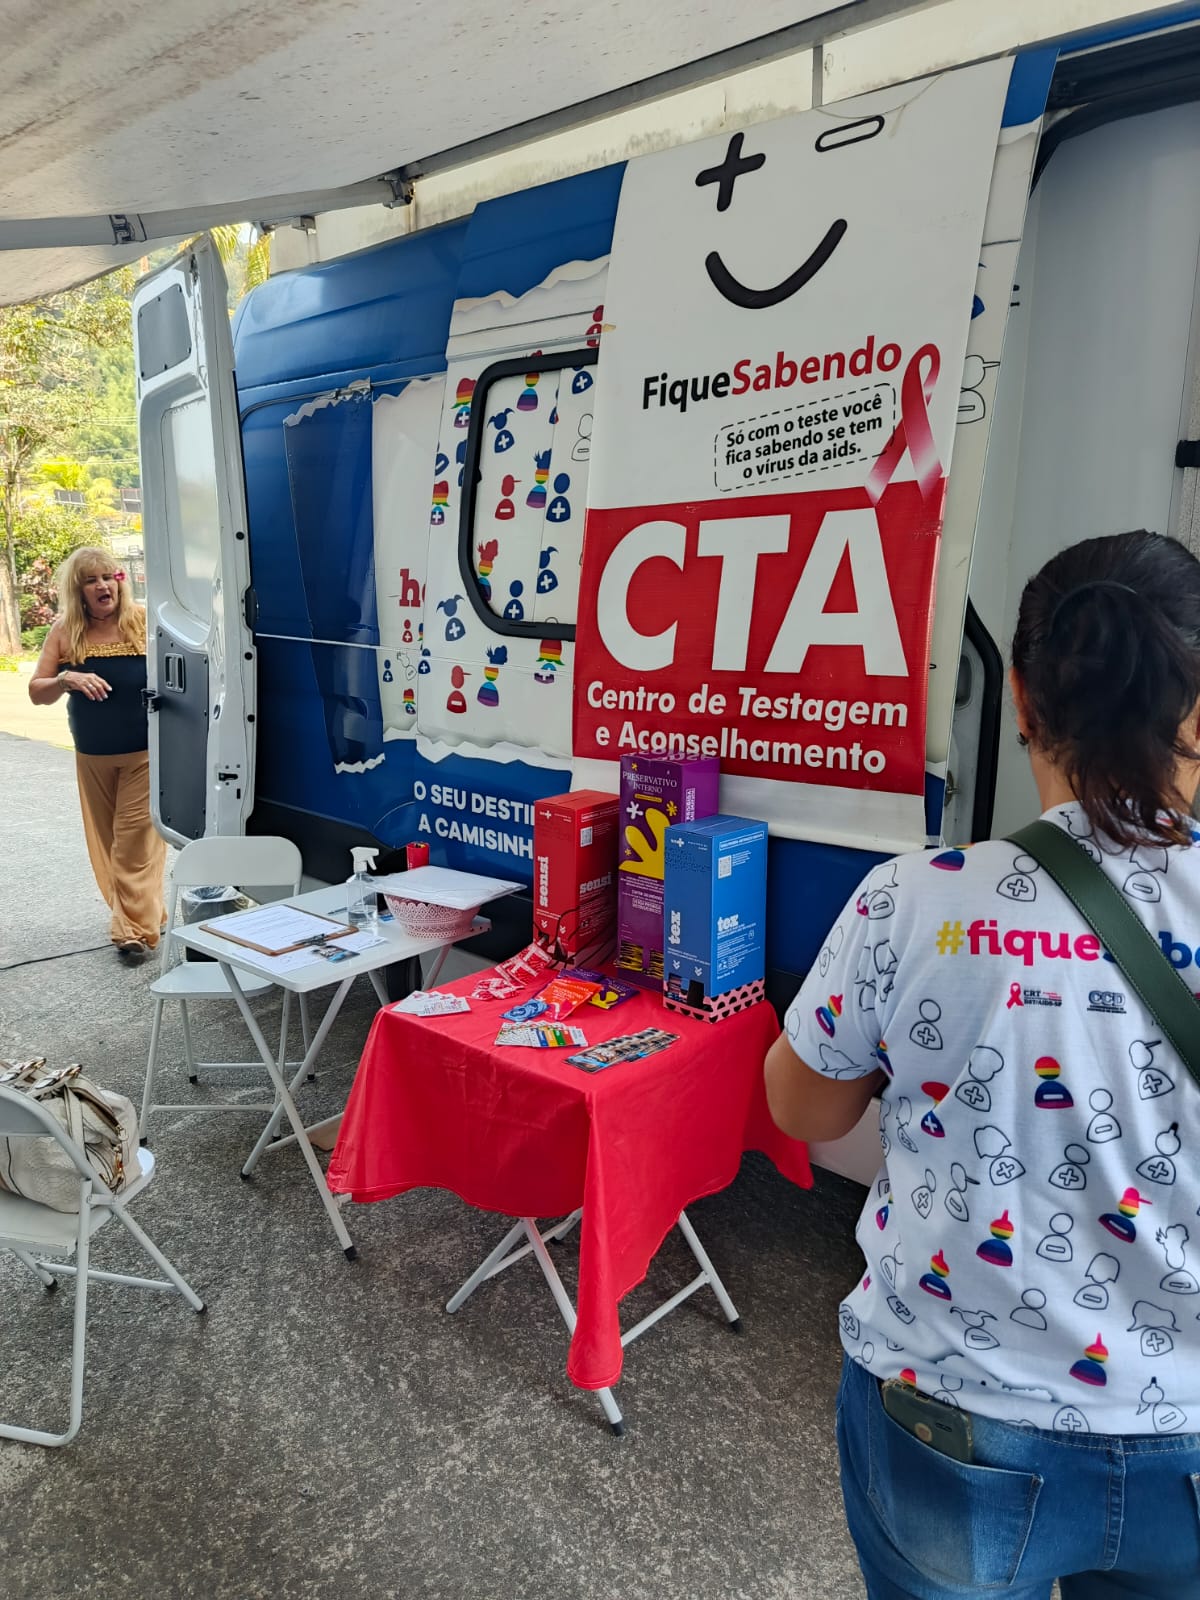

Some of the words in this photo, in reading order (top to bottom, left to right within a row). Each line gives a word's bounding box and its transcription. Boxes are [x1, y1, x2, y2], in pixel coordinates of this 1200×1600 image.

[642, 335, 903, 412] FiqueSabendo
[725, 448, 752, 466] fica
[755, 430, 823, 458] sabendo
[827, 425, 846, 441] se
[849, 416, 882, 436] tem
[726, 429, 745, 448] Só
[748, 422, 780, 442] com
[783, 420, 794, 433] o
[797, 408, 839, 429] teste
[842, 393, 882, 418] você
[743, 467, 753, 479] o
[756, 456, 795, 476] vírus
[797, 449, 819, 467] da
[822, 440, 862, 462] aids.
[399, 568, 426, 608] h
[596, 506, 910, 678] CTA
[586, 680, 676, 714] Centro
[688, 683, 727, 716] de
[737, 686, 909, 732] Testagem
[595, 725, 611, 747] e
[617, 720, 887, 775] Aconselhamento
[413, 780, 427, 801] O
[430, 783, 467, 810] SEU
[622, 769, 678, 788] PRESERVATIVO
[418, 813, 432, 834] A
[435, 817, 534, 860] CAMISINH
[537, 855, 549, 908] sensi
[579, 871, 613, 895] sensi
[668, 909, 682, 946] tex
[716, 913, 740, 932] tex
[1088, 989, 1126, 1007] CCD
